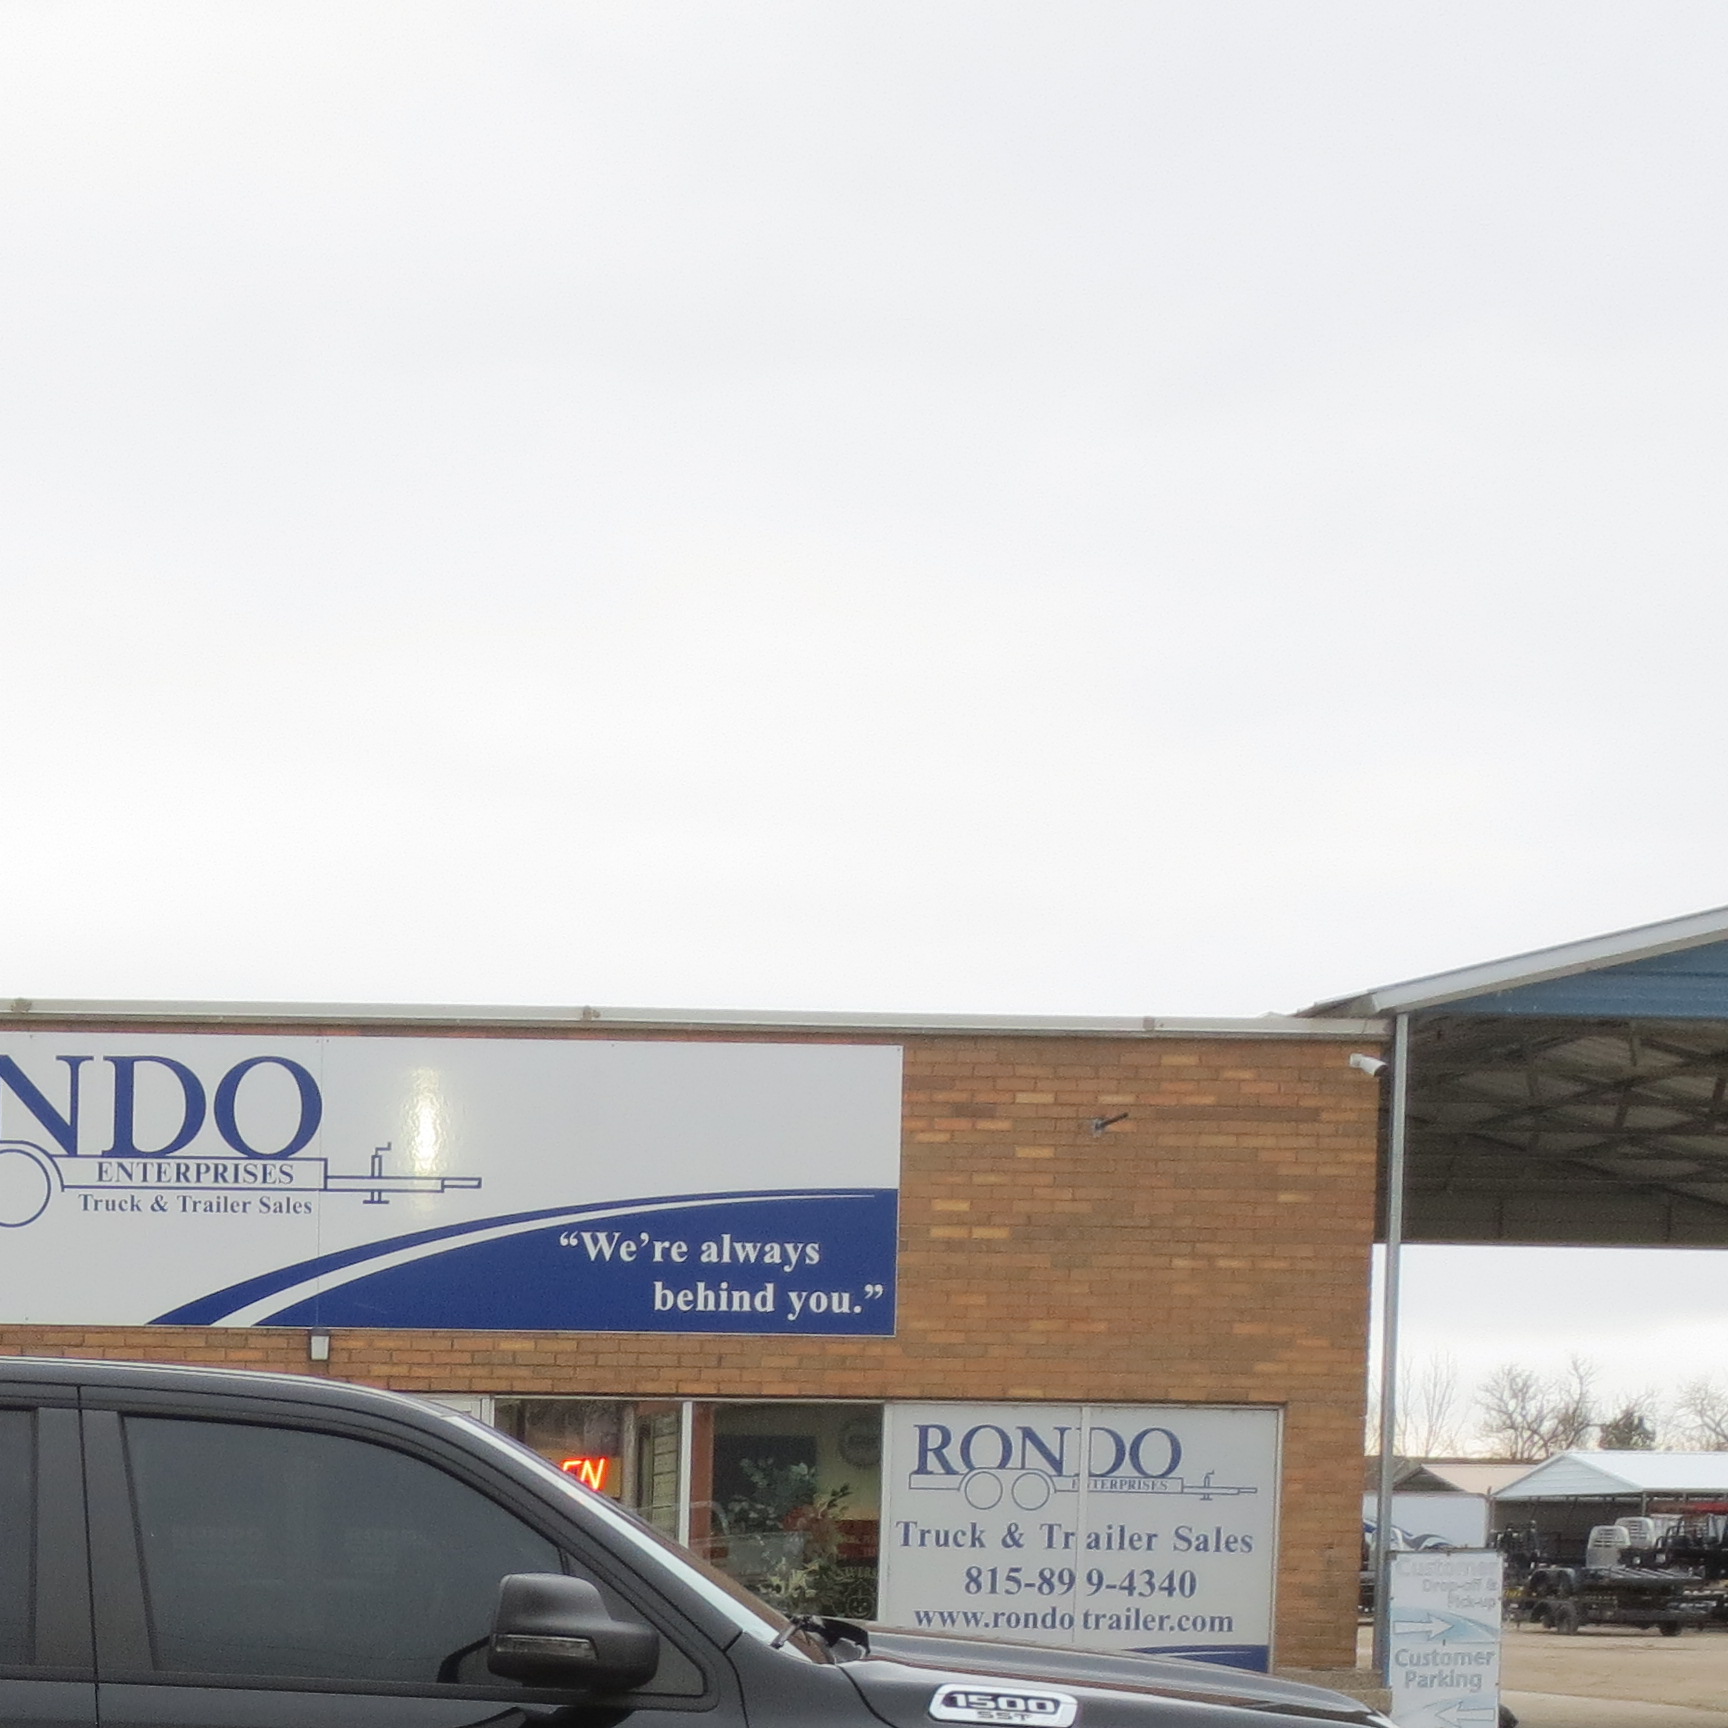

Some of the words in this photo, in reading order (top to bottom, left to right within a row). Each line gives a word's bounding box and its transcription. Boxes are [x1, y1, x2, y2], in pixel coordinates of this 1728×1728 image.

[96, 1161, 295, 1185] ENTERPRISES
[78, 1193, 143, 1212] Truck
[150, 1194, 168, 1212] &
[176, 1194, 252, 1214] Trailer
[258, 1195, 313, 1215] Sales
[699, 1233, 821, 1273] always
[653, 1281, 775, 1314] behind
[913, 1424, 1183, 1479] RONDO
[1072, 1478, 1169, 1491] ETERPRISES
[896, 1521, 987, 1549] Truck
[1001, 1522, 1025, 1549] &
[1039, 1523, 1159, 1552] Trailer
[1173, 1525, 1254, 1554] Sales
[963, 1566, 1198, 1599] 815-899-4340
[914, 1607, 1234, 1634] www.rondotrailer.com
[1394, 1648, 1496, 1668] Customer
[1404, 1669, 1483, 1693] Parking
[951, 1693, 1055, 1713] 1500
